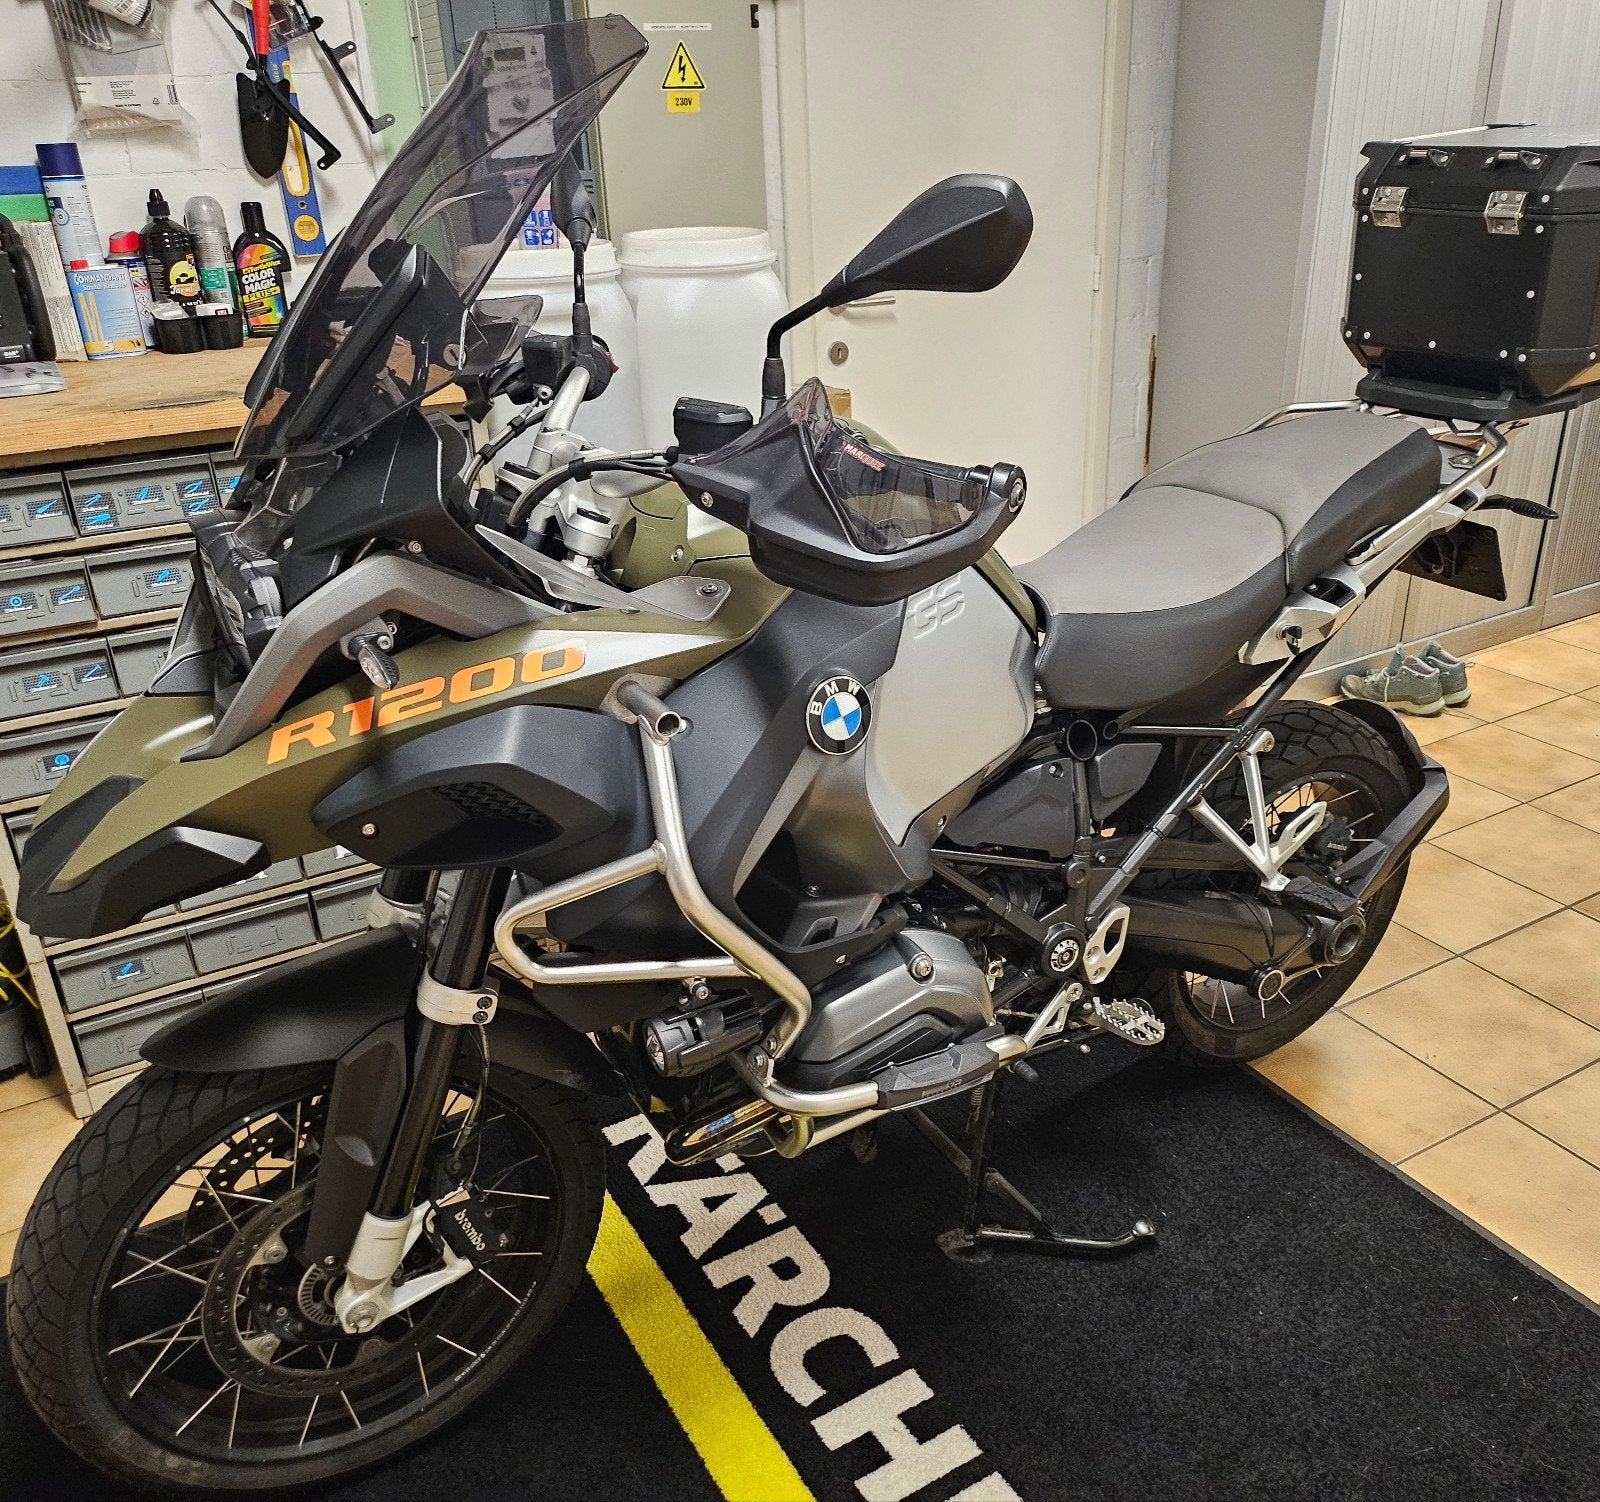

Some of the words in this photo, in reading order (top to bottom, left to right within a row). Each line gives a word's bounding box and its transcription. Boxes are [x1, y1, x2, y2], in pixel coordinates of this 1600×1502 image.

[675, 97, 692, 106] 230V
[242, 267, 275, 284] COLOR
[244, 277, 276, 294] MAGIC
[267, 637, 587, 765] R1200
[810, 680, 861, 715] BMW
[454, 1208, 486, 1251] brembo
[601, 1113, 1024, 1502] ÄRCH
